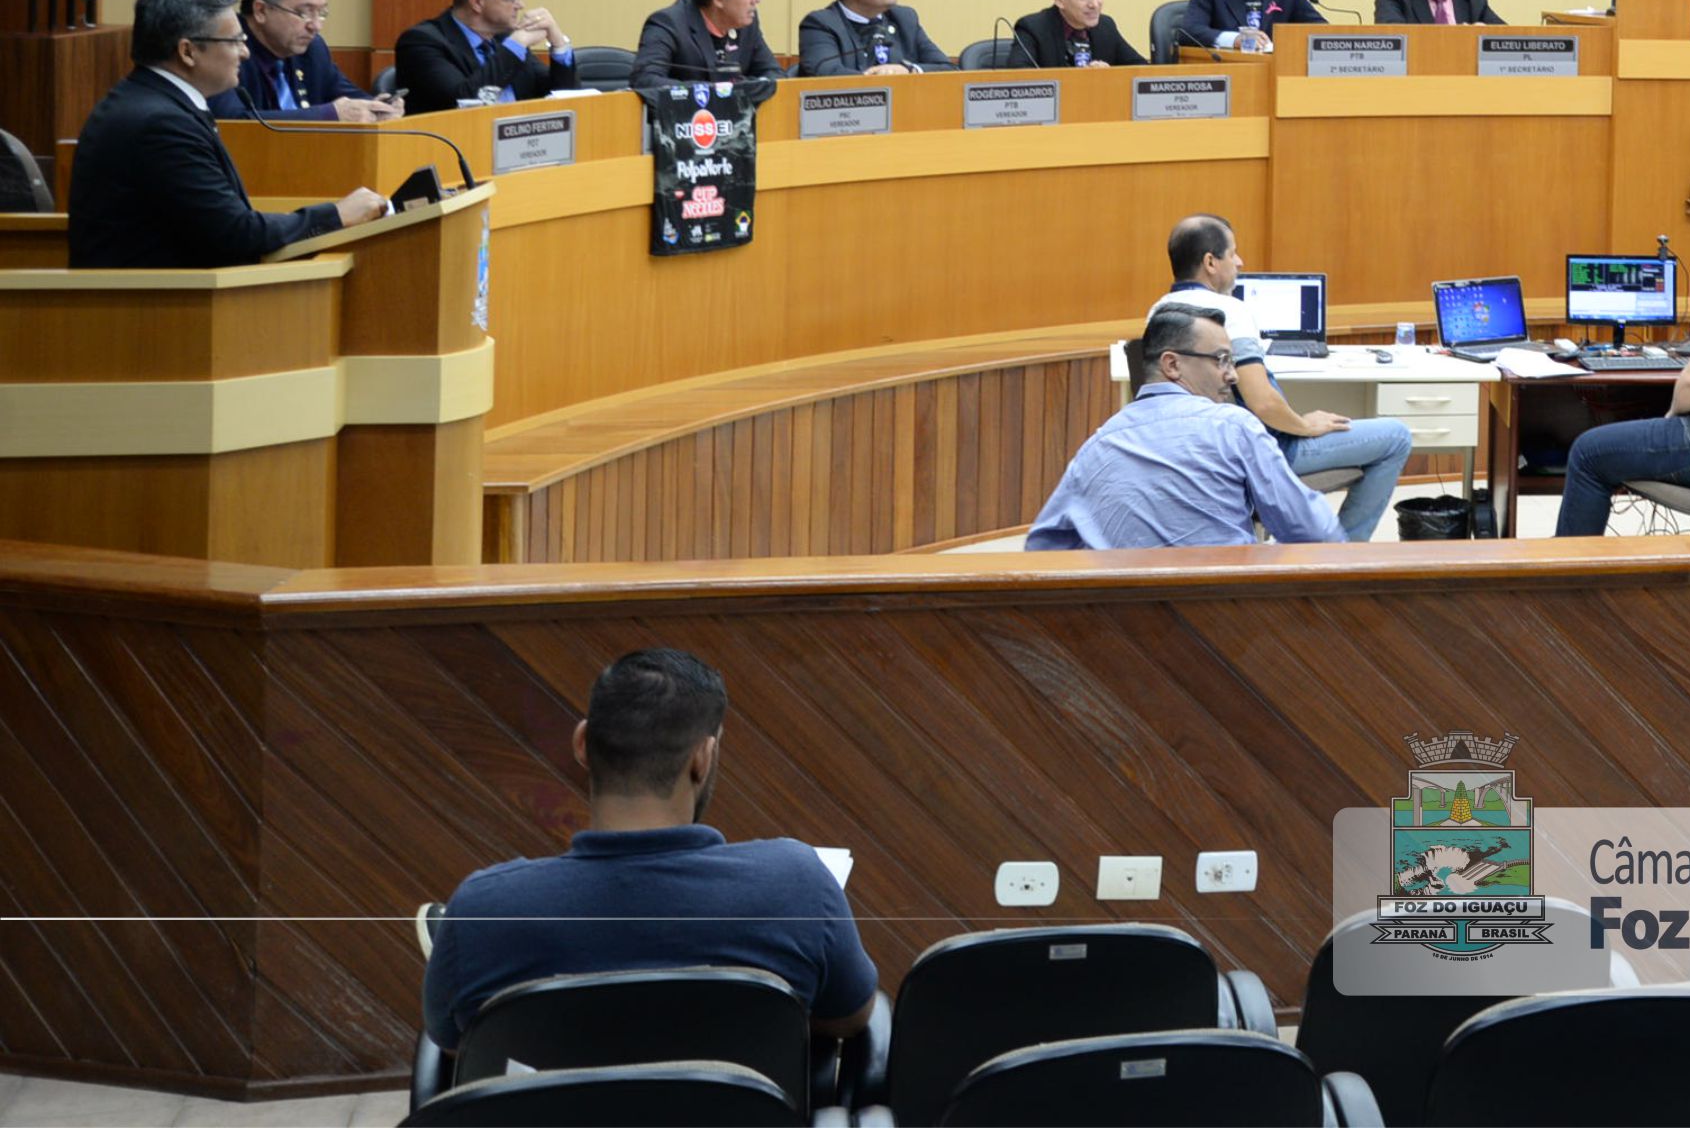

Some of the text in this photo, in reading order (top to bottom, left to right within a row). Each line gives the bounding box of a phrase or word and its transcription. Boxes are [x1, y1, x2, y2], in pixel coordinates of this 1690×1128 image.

[1320, 40, 1394, 50] EDSON NARIZÃO
[1490, 41, 1566, 50] ELIZEU LIBERATO
[970, 86, 1053, 99] ROGÉRIO QUADROS
[1150, 82, 1213, 92] MARCIO ROSA
[833, 94, 885, 107] DALL'AGNOL
[675, 119, 733, 139] NISSEI
